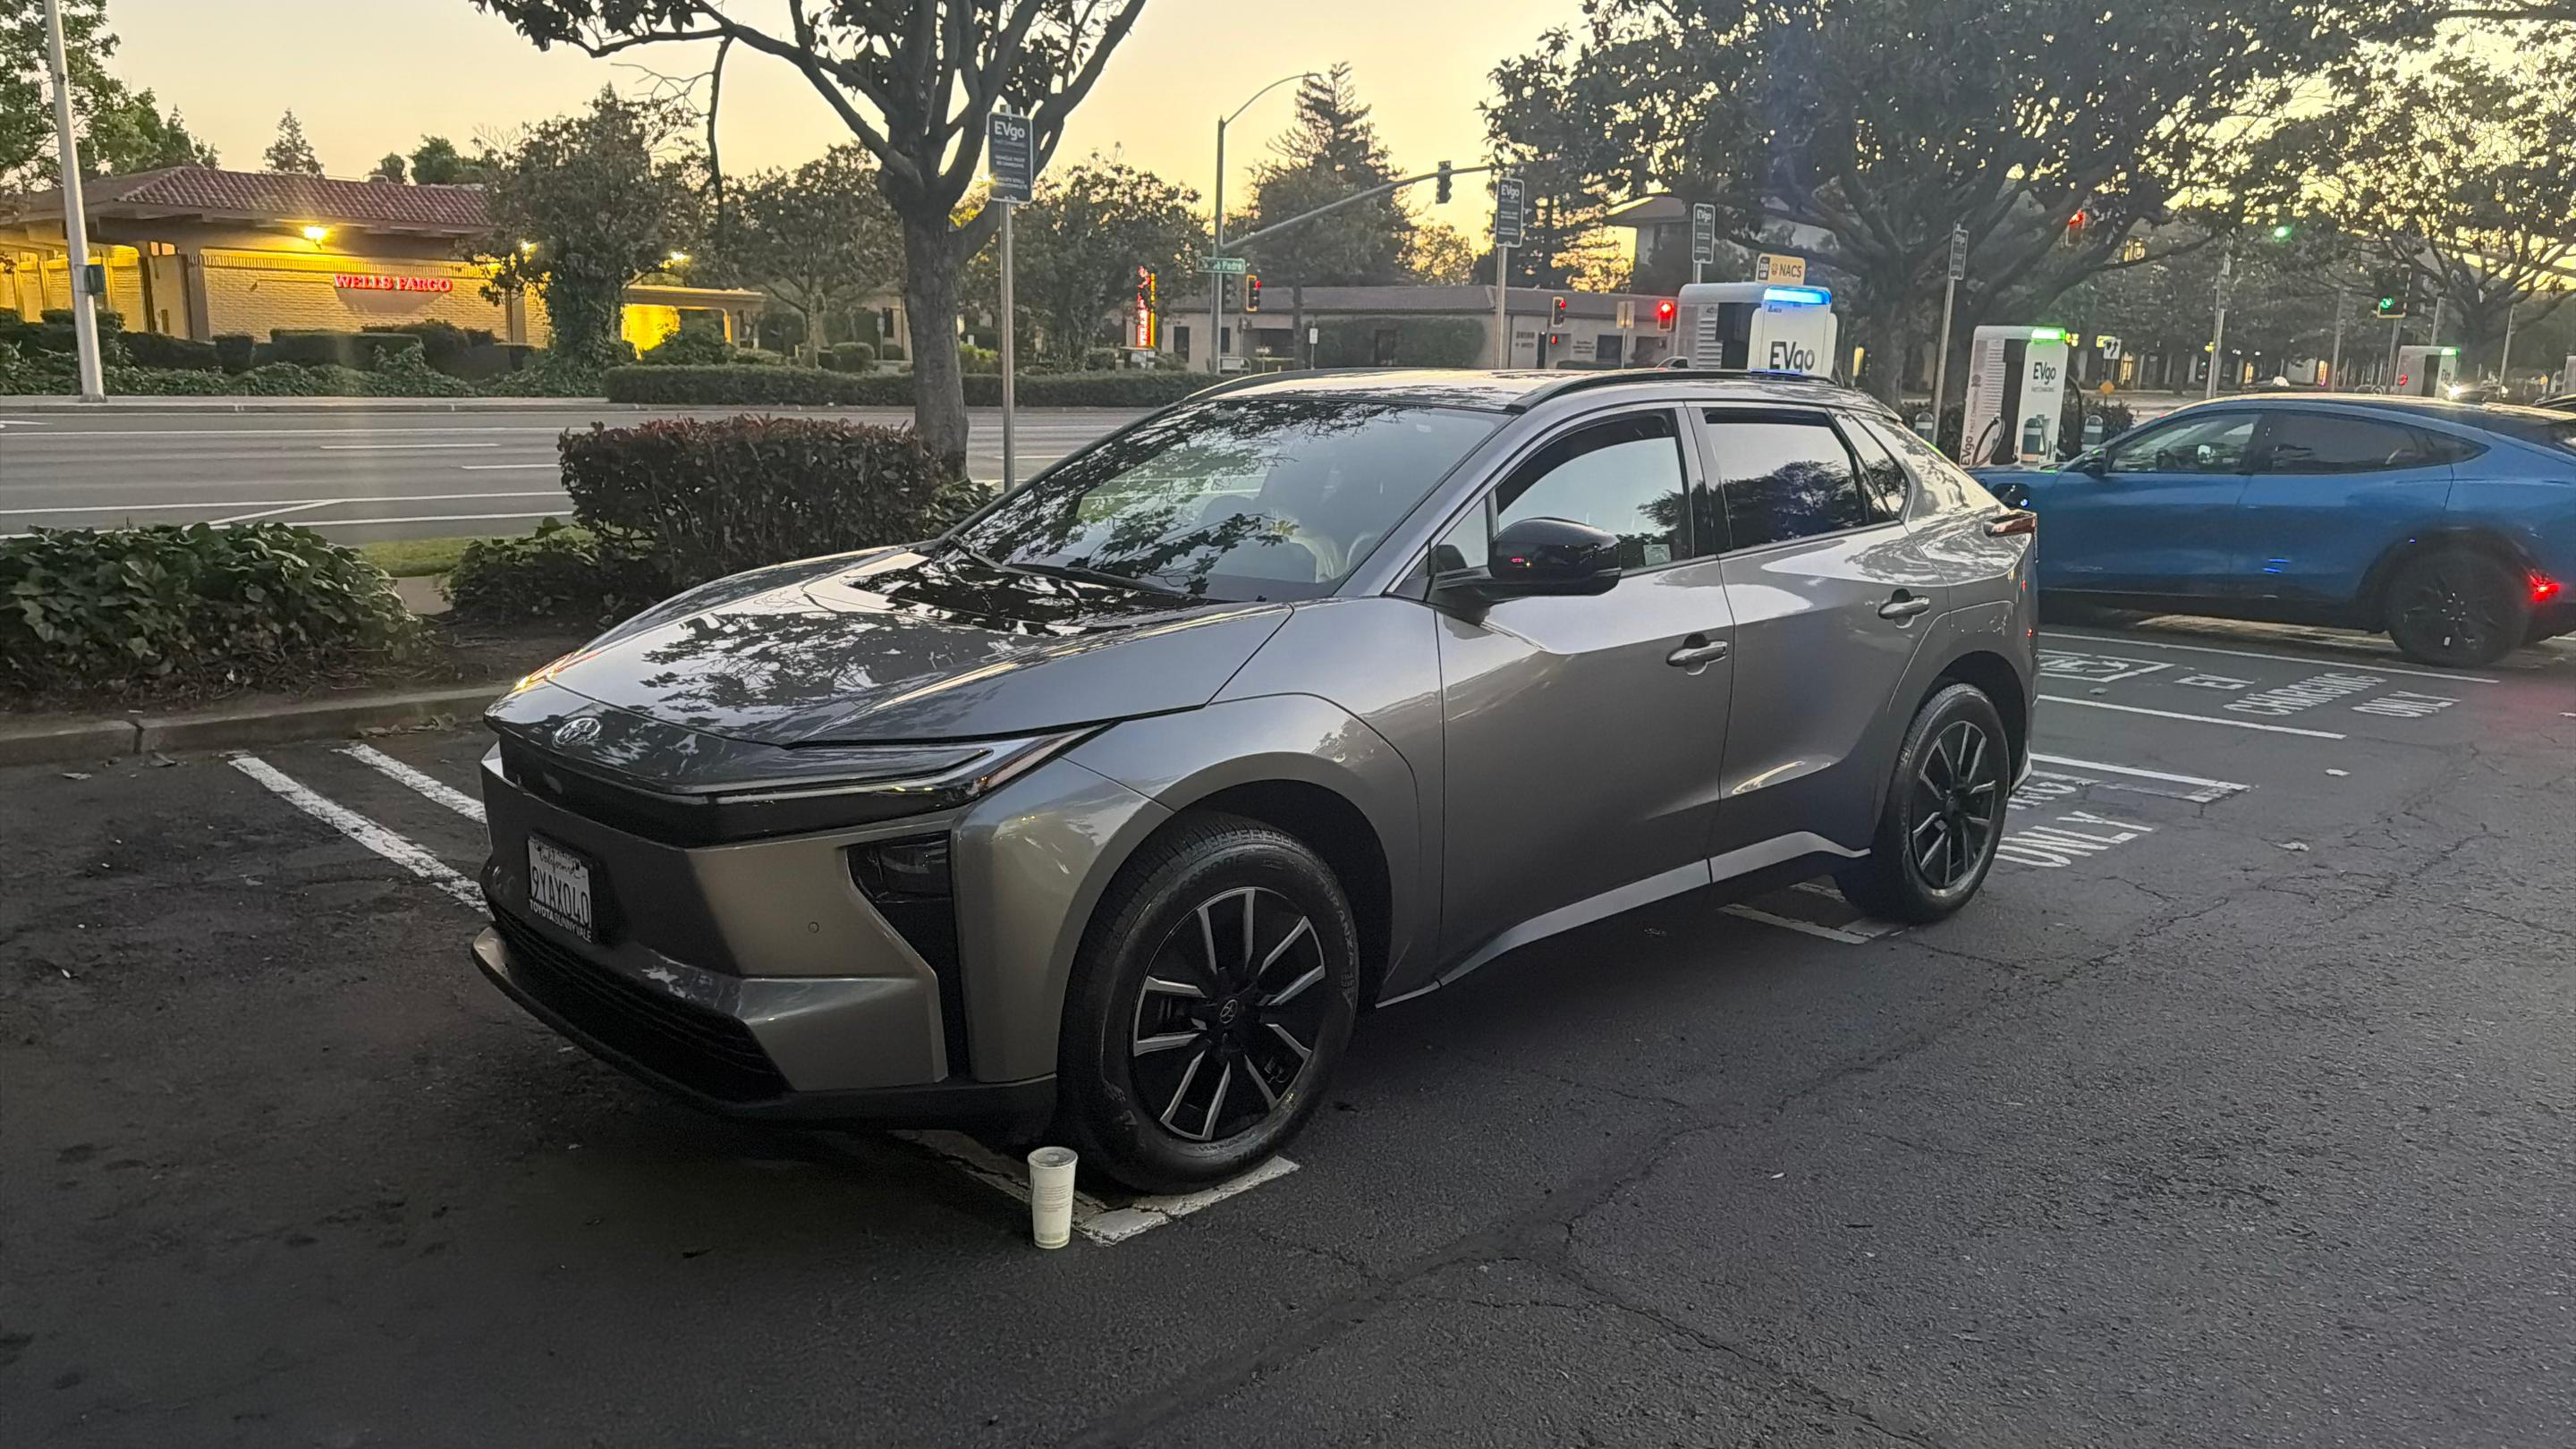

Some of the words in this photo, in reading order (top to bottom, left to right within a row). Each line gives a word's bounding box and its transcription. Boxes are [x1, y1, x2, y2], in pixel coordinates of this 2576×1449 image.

[994, 120, 1026, 140] EVgo
[1501, 184, 1520, 199] EVgo
[335, 274, 394, 291] WELLS
[396, 276, 453, 292] FARGO
[1779, 263, 1802, 278] NACS
[1769, 342, 1815, 372] EVgo
[2033, 361, 2056, 385] EVgo
[1961, 436, 1975, 465] EVgo
[2224, 672, 2387, 716] CHARGING
[2351, 691, 2461, 717] ONLY
[1994, 810, 2153, 868] ONLY
[530, 898, 555, 922] TOYOTA
[555, 911, 592, 944] SUNNYVALE
